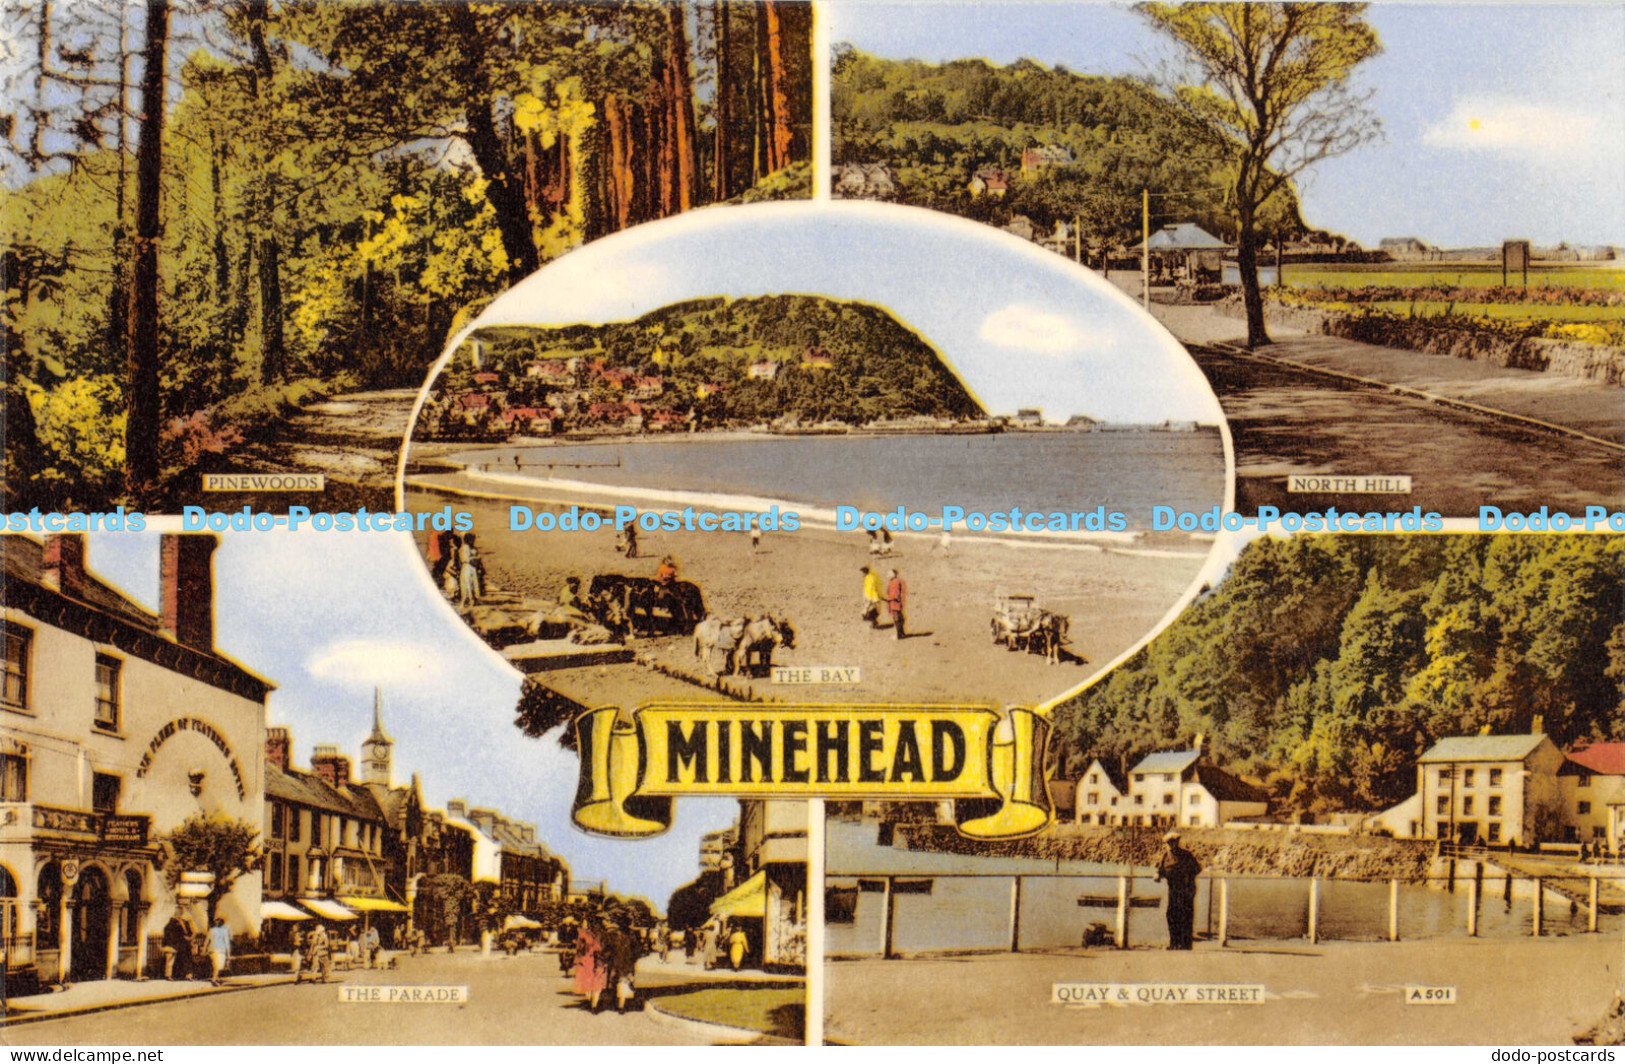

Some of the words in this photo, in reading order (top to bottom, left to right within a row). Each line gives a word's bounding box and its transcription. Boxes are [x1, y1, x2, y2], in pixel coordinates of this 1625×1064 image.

[208, 476, 319, 490] PINEWOODS
[1293, 478, 1357, 492] NORTH
[1364, 478, 1407, 492] HILL
[775, 670, 812, 682] THE
[821, 670, 855, 682] BAY
[150, 721, 176, 753] PLUME
[177, 718, 188, 730] OF
[192, 718, 230, 758] FEATHERS
[665, 719, 966, 784] MINEHEAD
[345, 988, 380, 1000] THE
[389, 988, 460, 1000] PARADE
[1057, 987, 1110, 1001] QUAY
[1117, 988, 1129, 1000] &
[1137, 987, 1188, 1001] QUAY
[1196, 987, 1260, 1001] STREET
